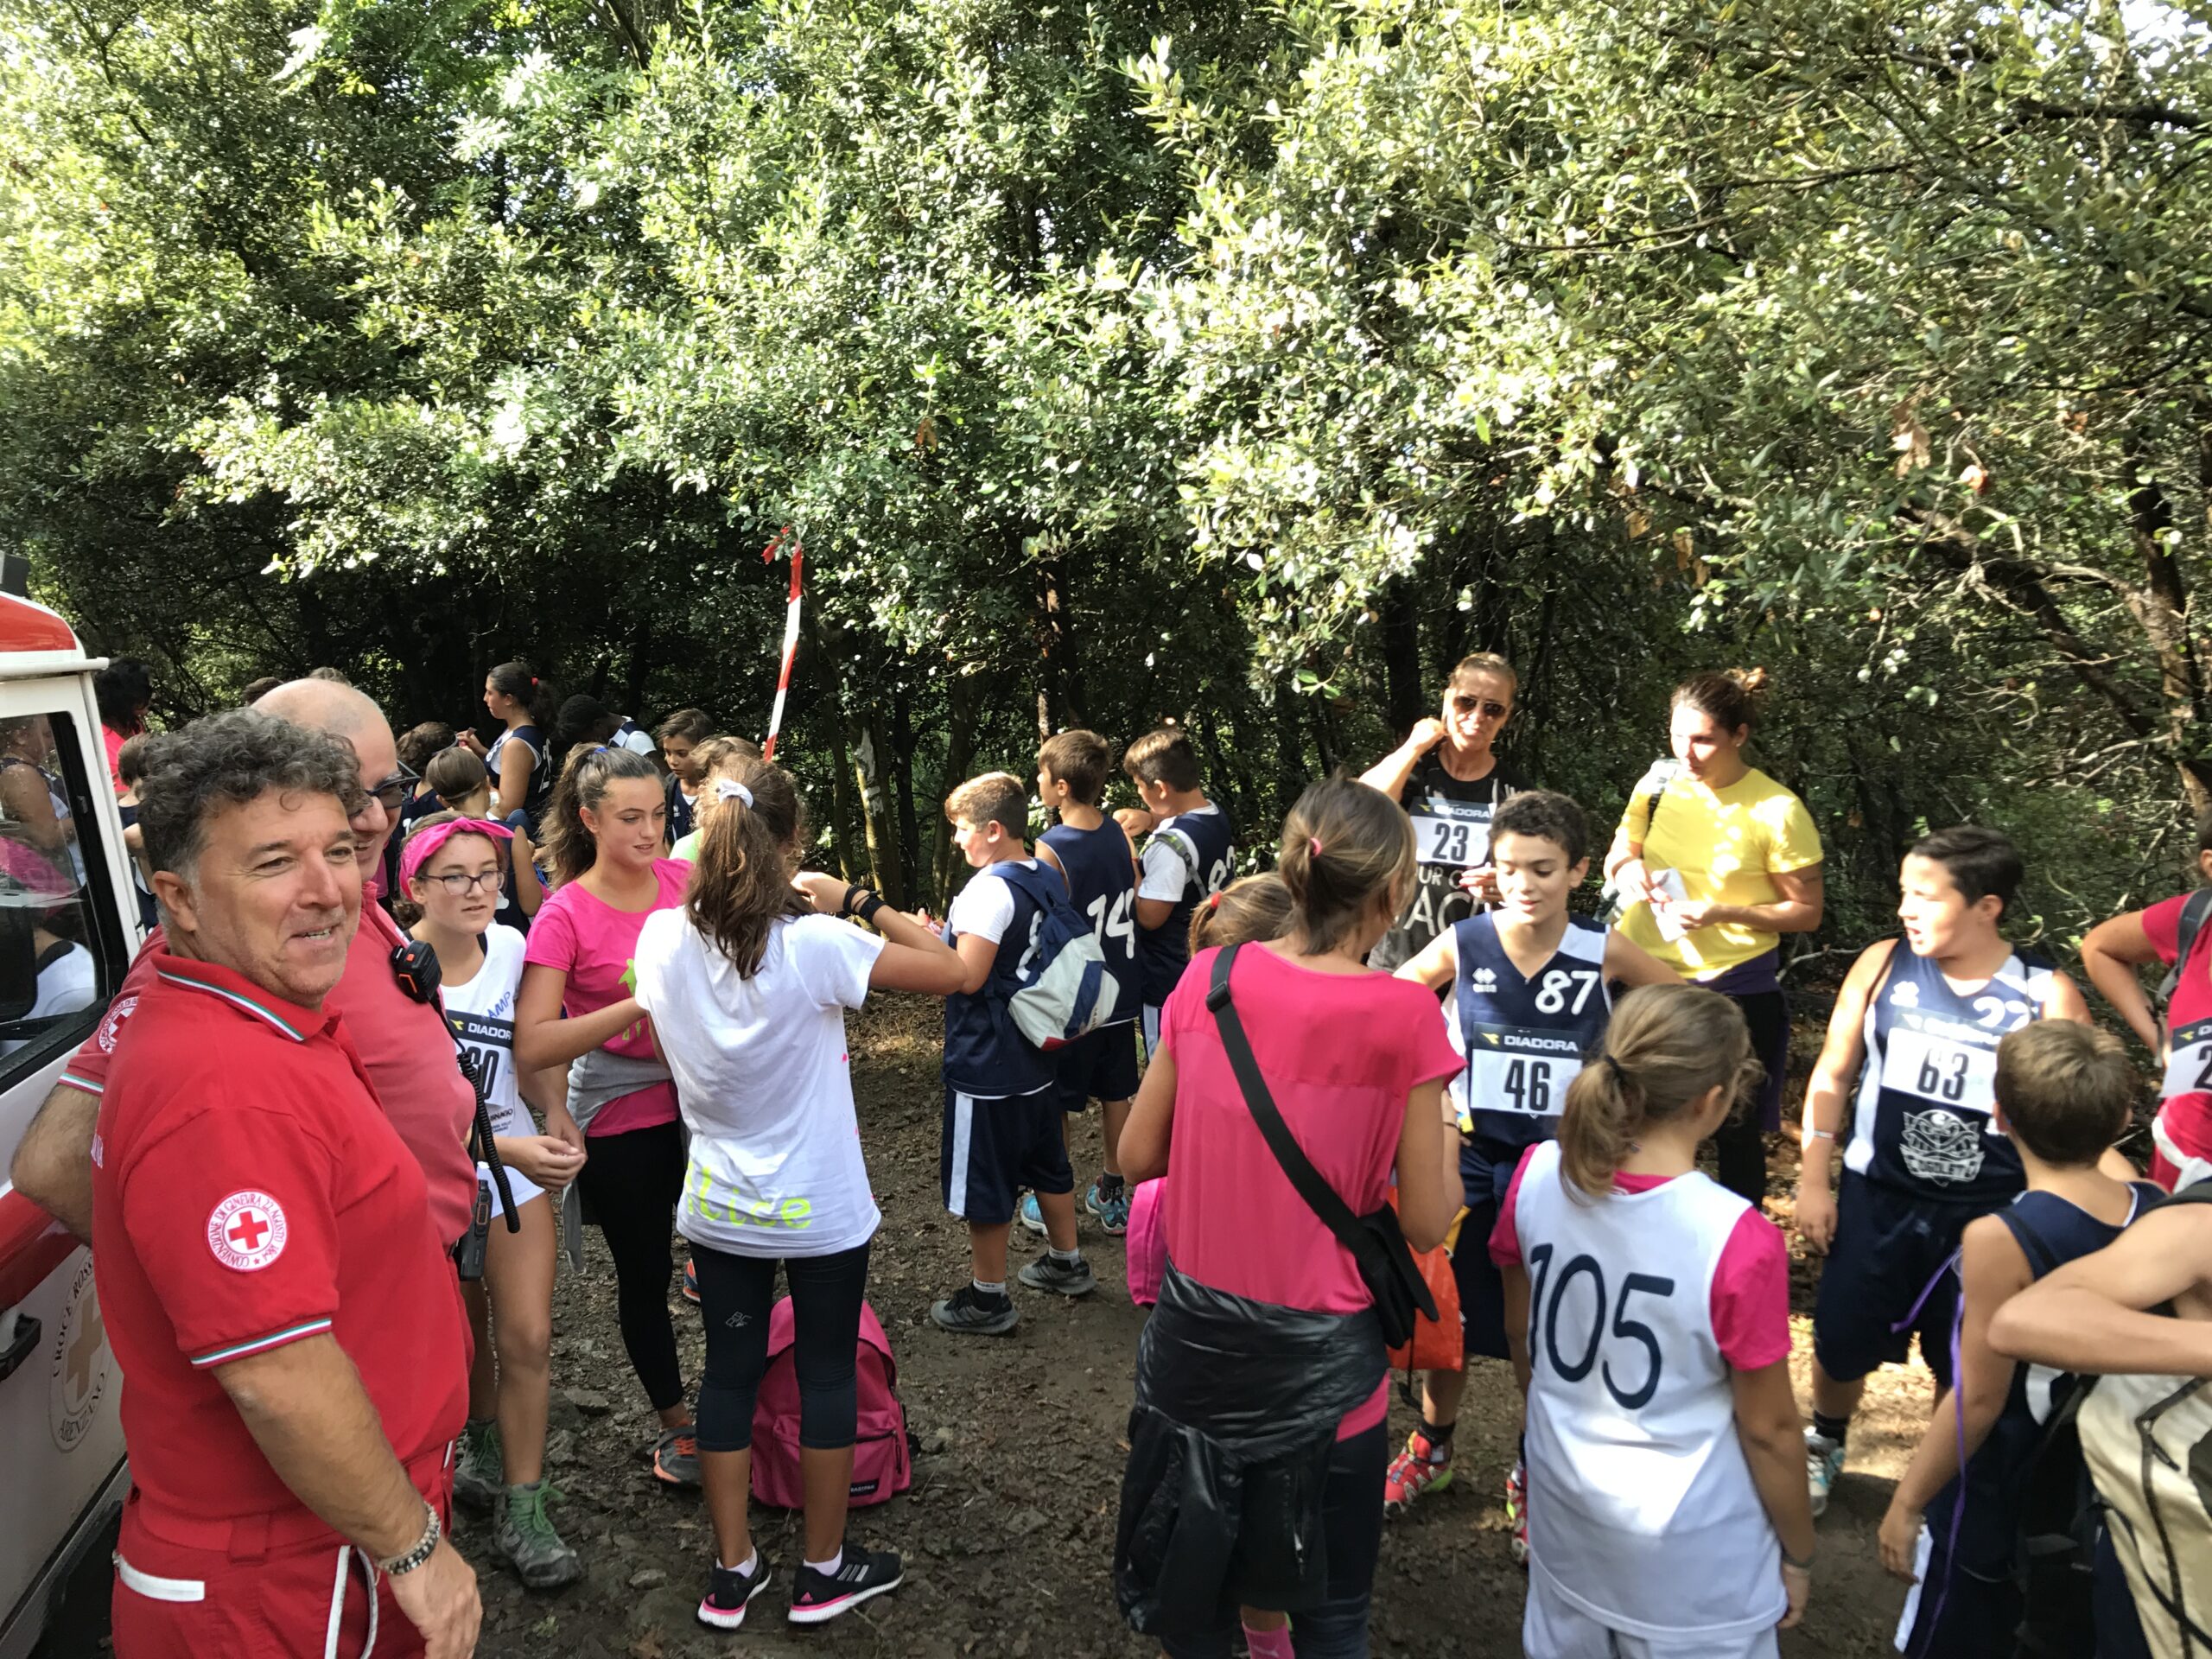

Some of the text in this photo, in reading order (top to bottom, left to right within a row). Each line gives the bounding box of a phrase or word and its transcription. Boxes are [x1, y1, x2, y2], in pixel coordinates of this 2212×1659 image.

[1434, 804, 1491, 818] ADORA
[1432, 823, 1469, 862] 23
[1087, 887, 1135, 959] 14
[484, 991, 512, 1020] AMP
[1535, 969, 1600, 1015] 87
[467, 1022, 513, 1041] DIADOR
[1503, 1035, 1579, 1052] DIADORA
[1503, 1058, 1550, 1111] 46
[1916, 1048, 1969, 1101] 63
[214, 1208, 227, 1221] DI
[224, 1193, 261, 1211] GINEVRA
[262, 1198, 274, 1211] 22
[209, 1221, 250, 1268] CONVENZIONE
[72, 1255, 94, 1300] ROSS
[1529, 1243, 1675, 1410] 105
